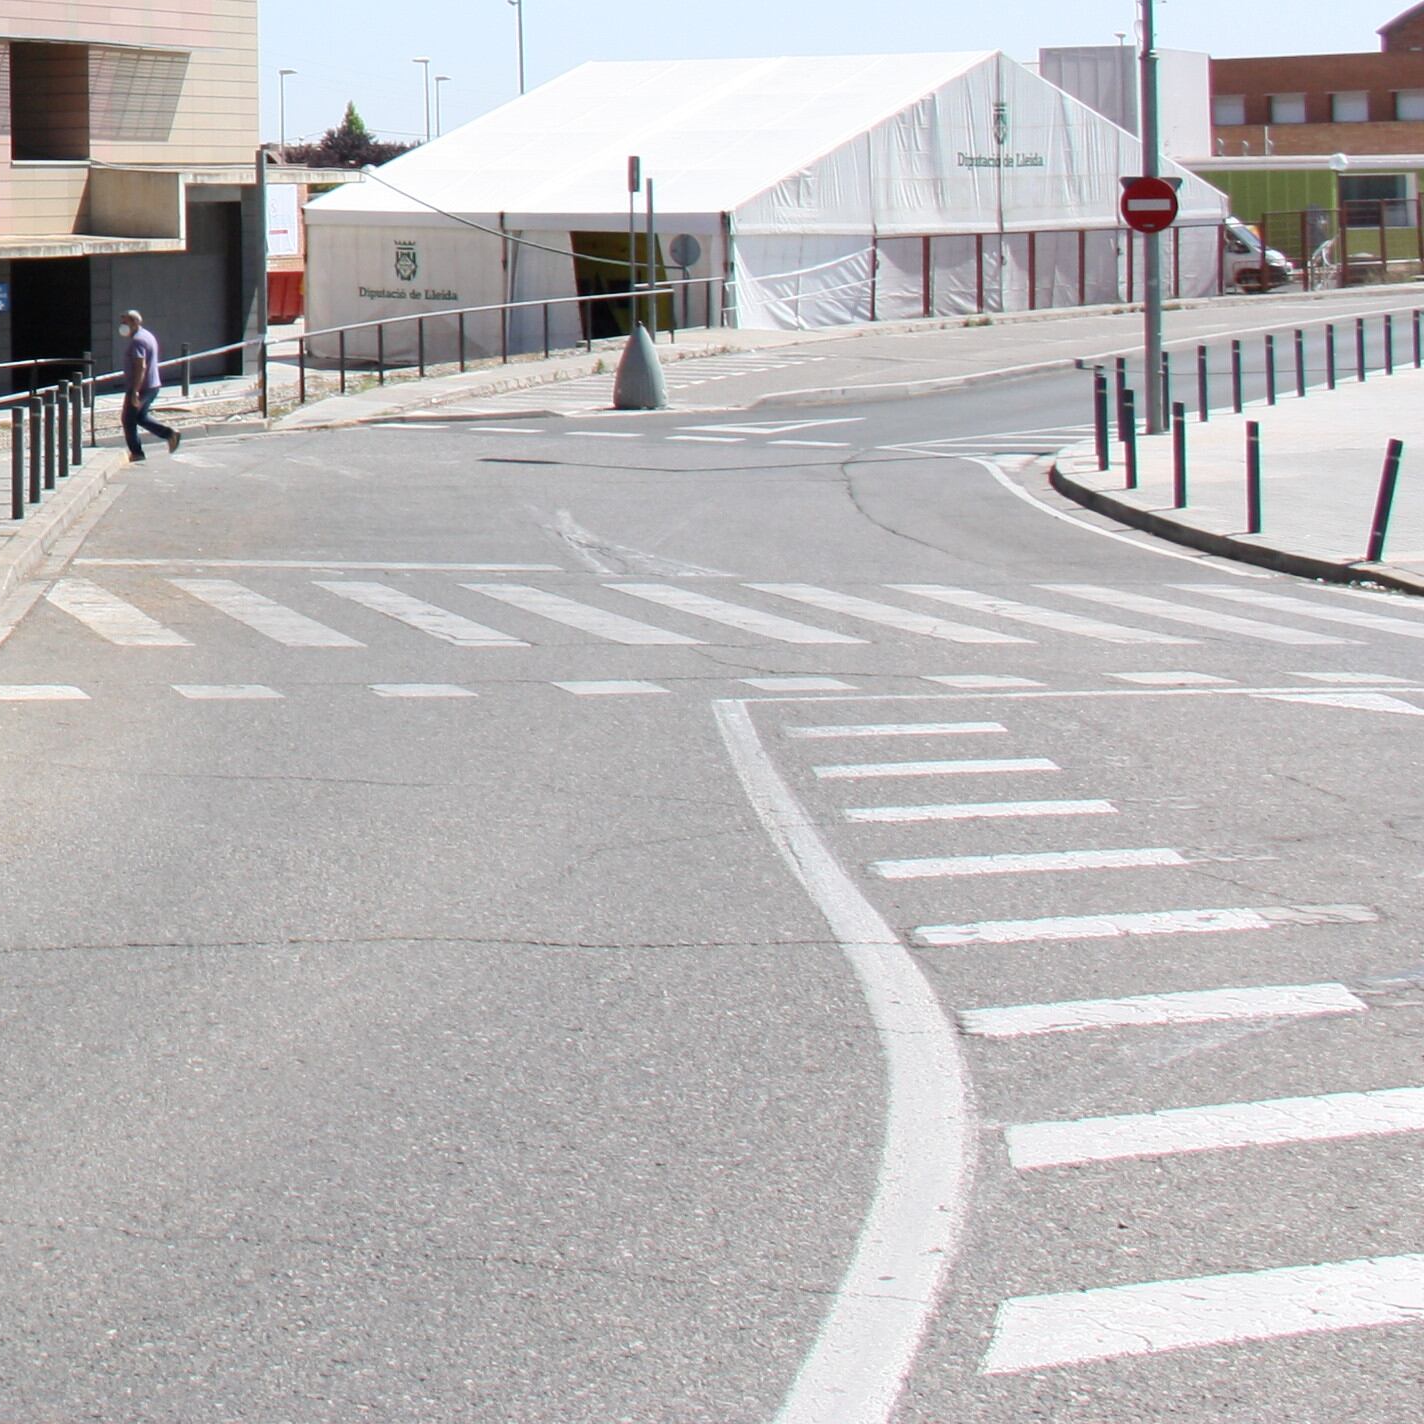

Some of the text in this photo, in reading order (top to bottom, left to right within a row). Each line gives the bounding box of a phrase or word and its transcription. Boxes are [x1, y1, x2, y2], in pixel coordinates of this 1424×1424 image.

[1015, 152, 1044, 167] Lleida
[358, 286, 458, 301] Diputació de Lleida
